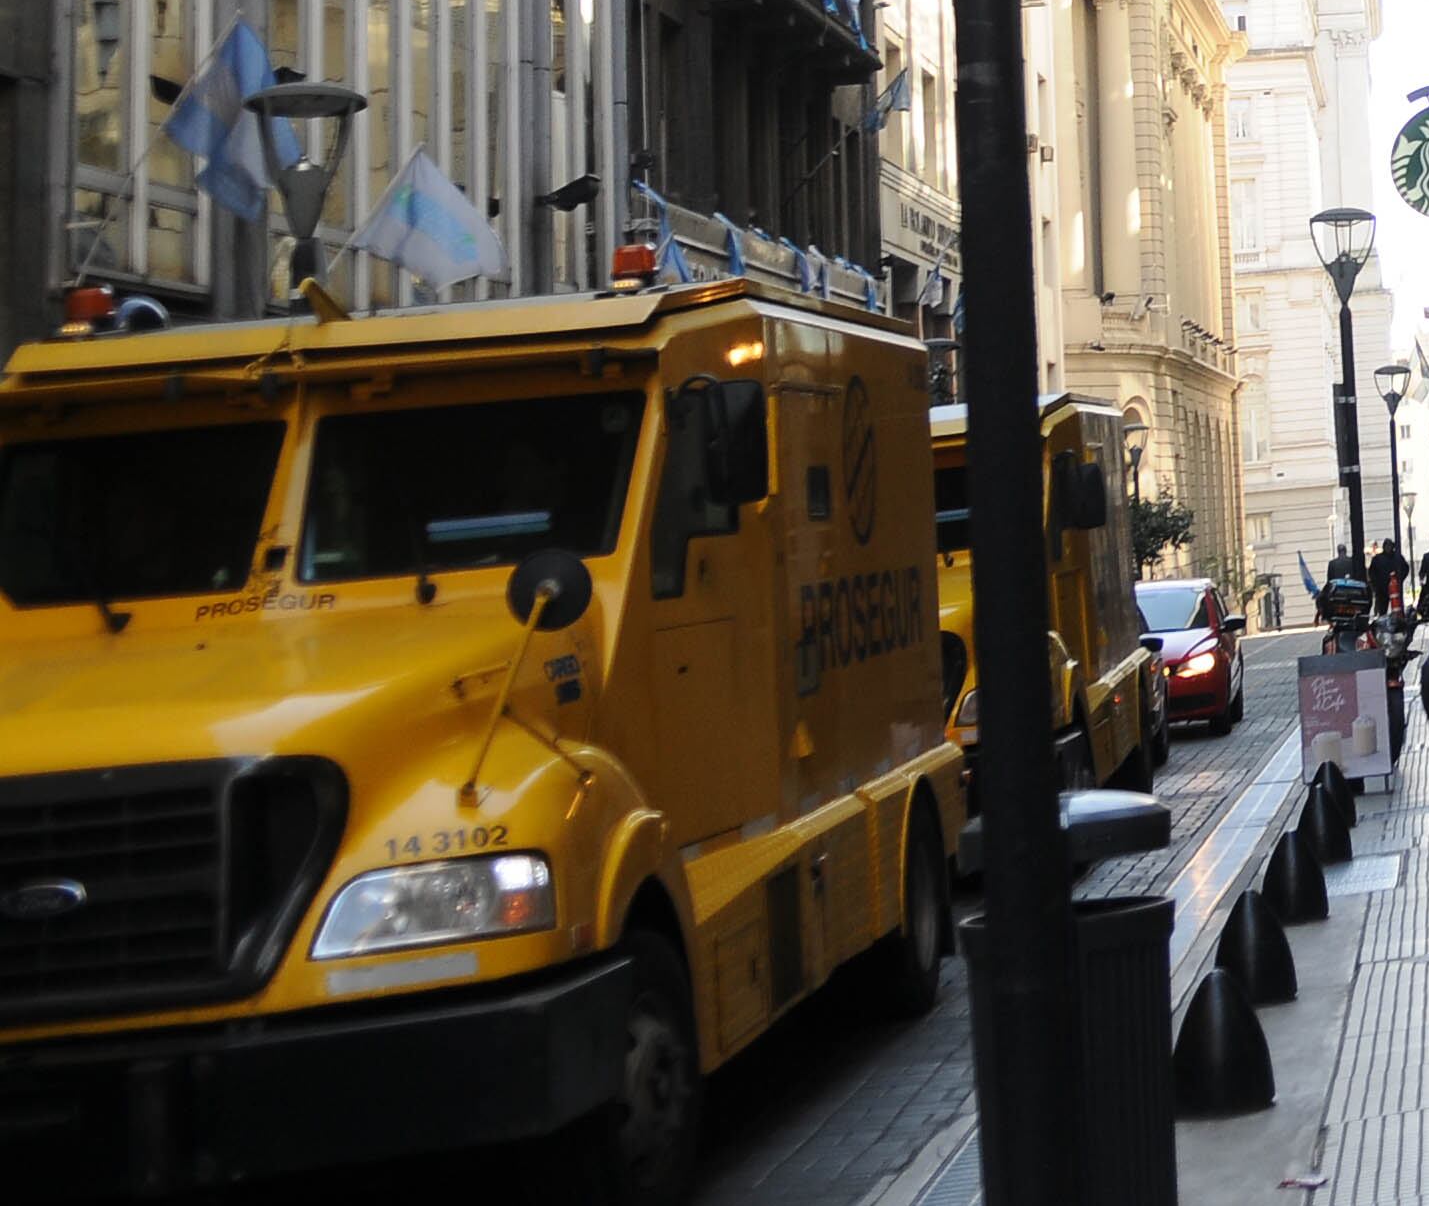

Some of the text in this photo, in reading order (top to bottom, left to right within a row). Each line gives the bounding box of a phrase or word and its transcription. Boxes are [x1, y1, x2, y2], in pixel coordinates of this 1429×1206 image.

[194, 593, 337, 623] PROSEGUR
[800, 564, 921, 672] PROSEGUR
[384, 824, 509, 860] 14 3102
